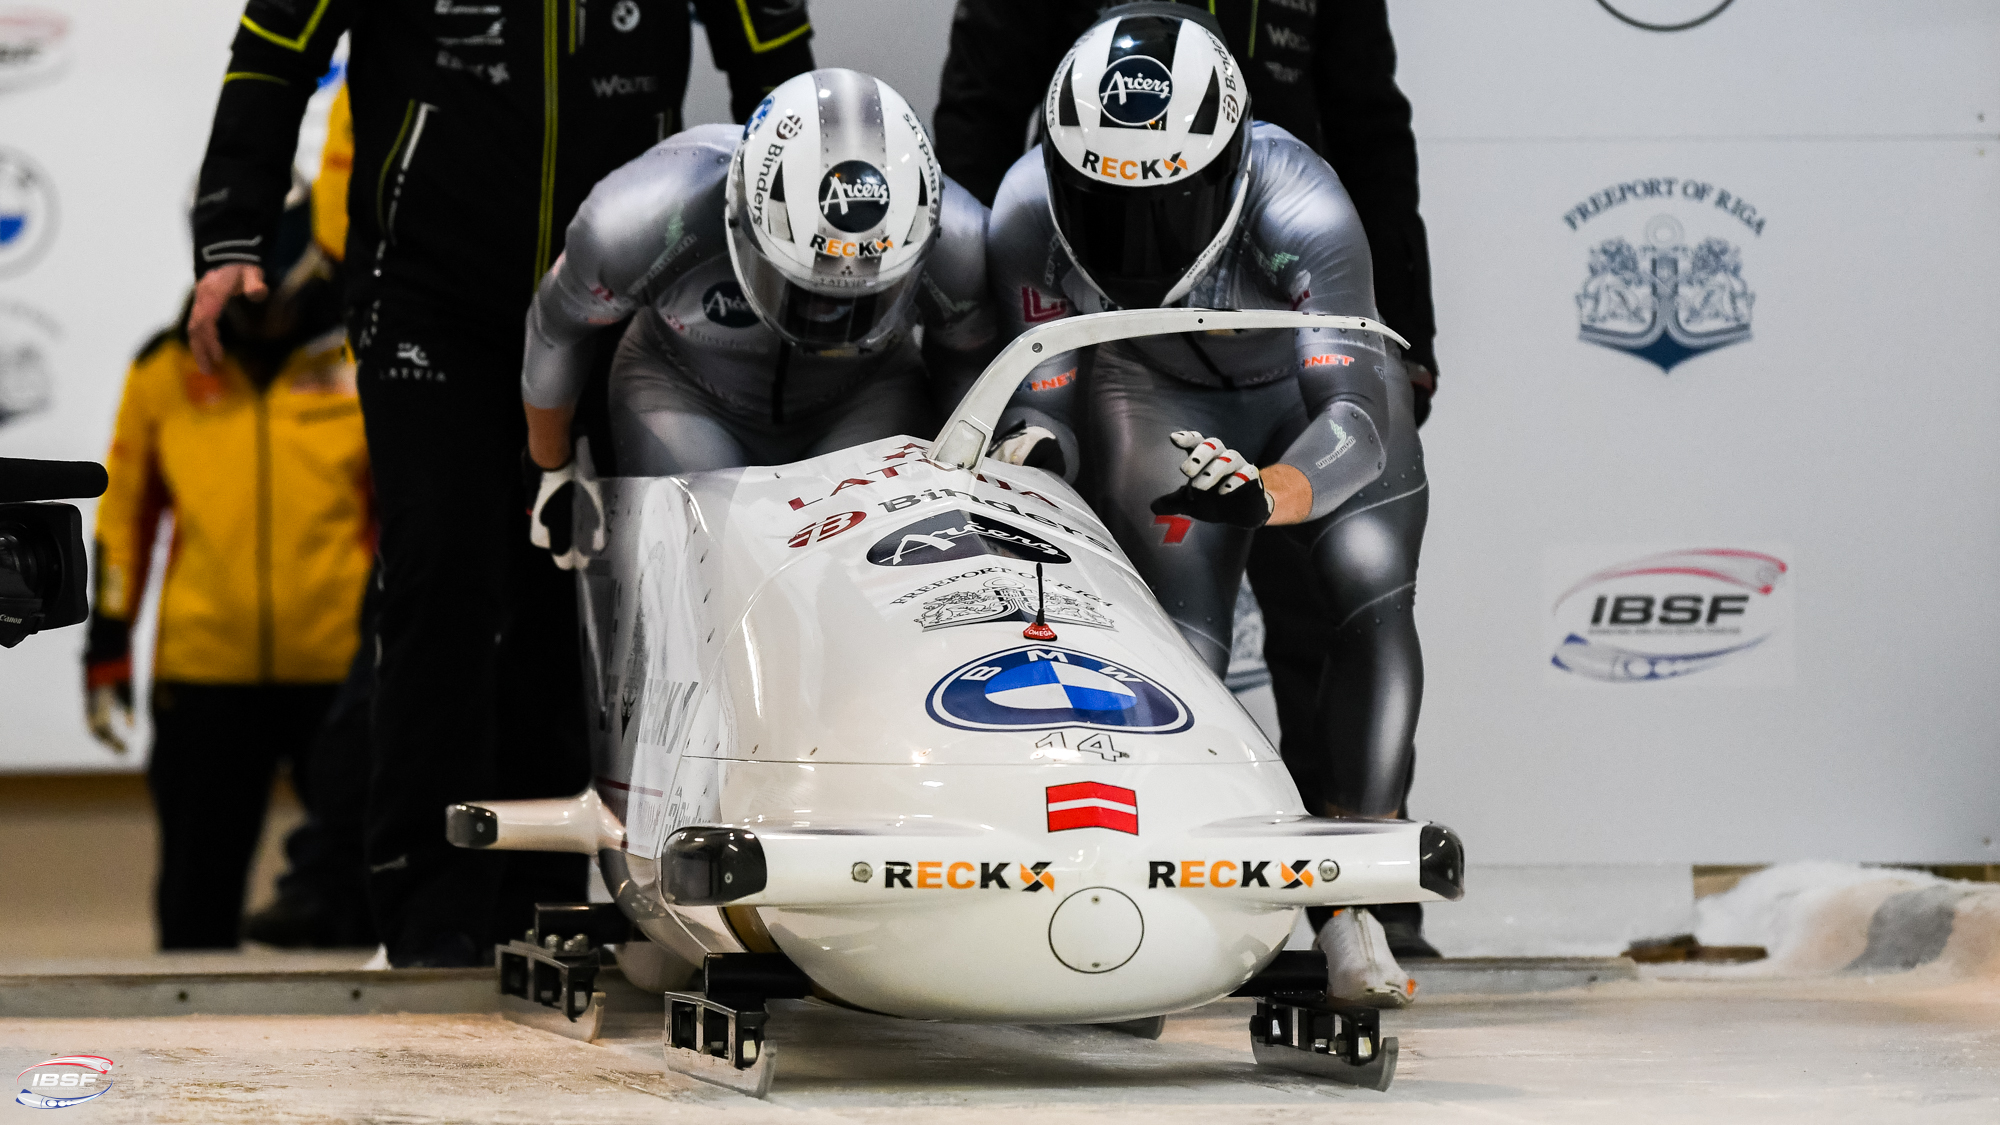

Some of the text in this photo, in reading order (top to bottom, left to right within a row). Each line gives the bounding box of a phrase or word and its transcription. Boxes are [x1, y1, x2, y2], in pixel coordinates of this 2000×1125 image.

[1202, 28, 1237, 92] Bnders
[751, 143, 785, 227] Binders
[1563, 177, 1767, 237] FREEPORT OF RIGA
[788, 460, 1062, 511] LATIA
[878, 488, 1113, 553] Binders
[889, 566, 1012, 606] FREEPORT
[1056, 582, 1114, 608] RIGA
[1590, 594, 1749, 626] IBSF
[1028, 629, 1053, 637] OMEGA
[961, 650, 1144, 683] BMW
[1035, 732, 1125, 762] 14
